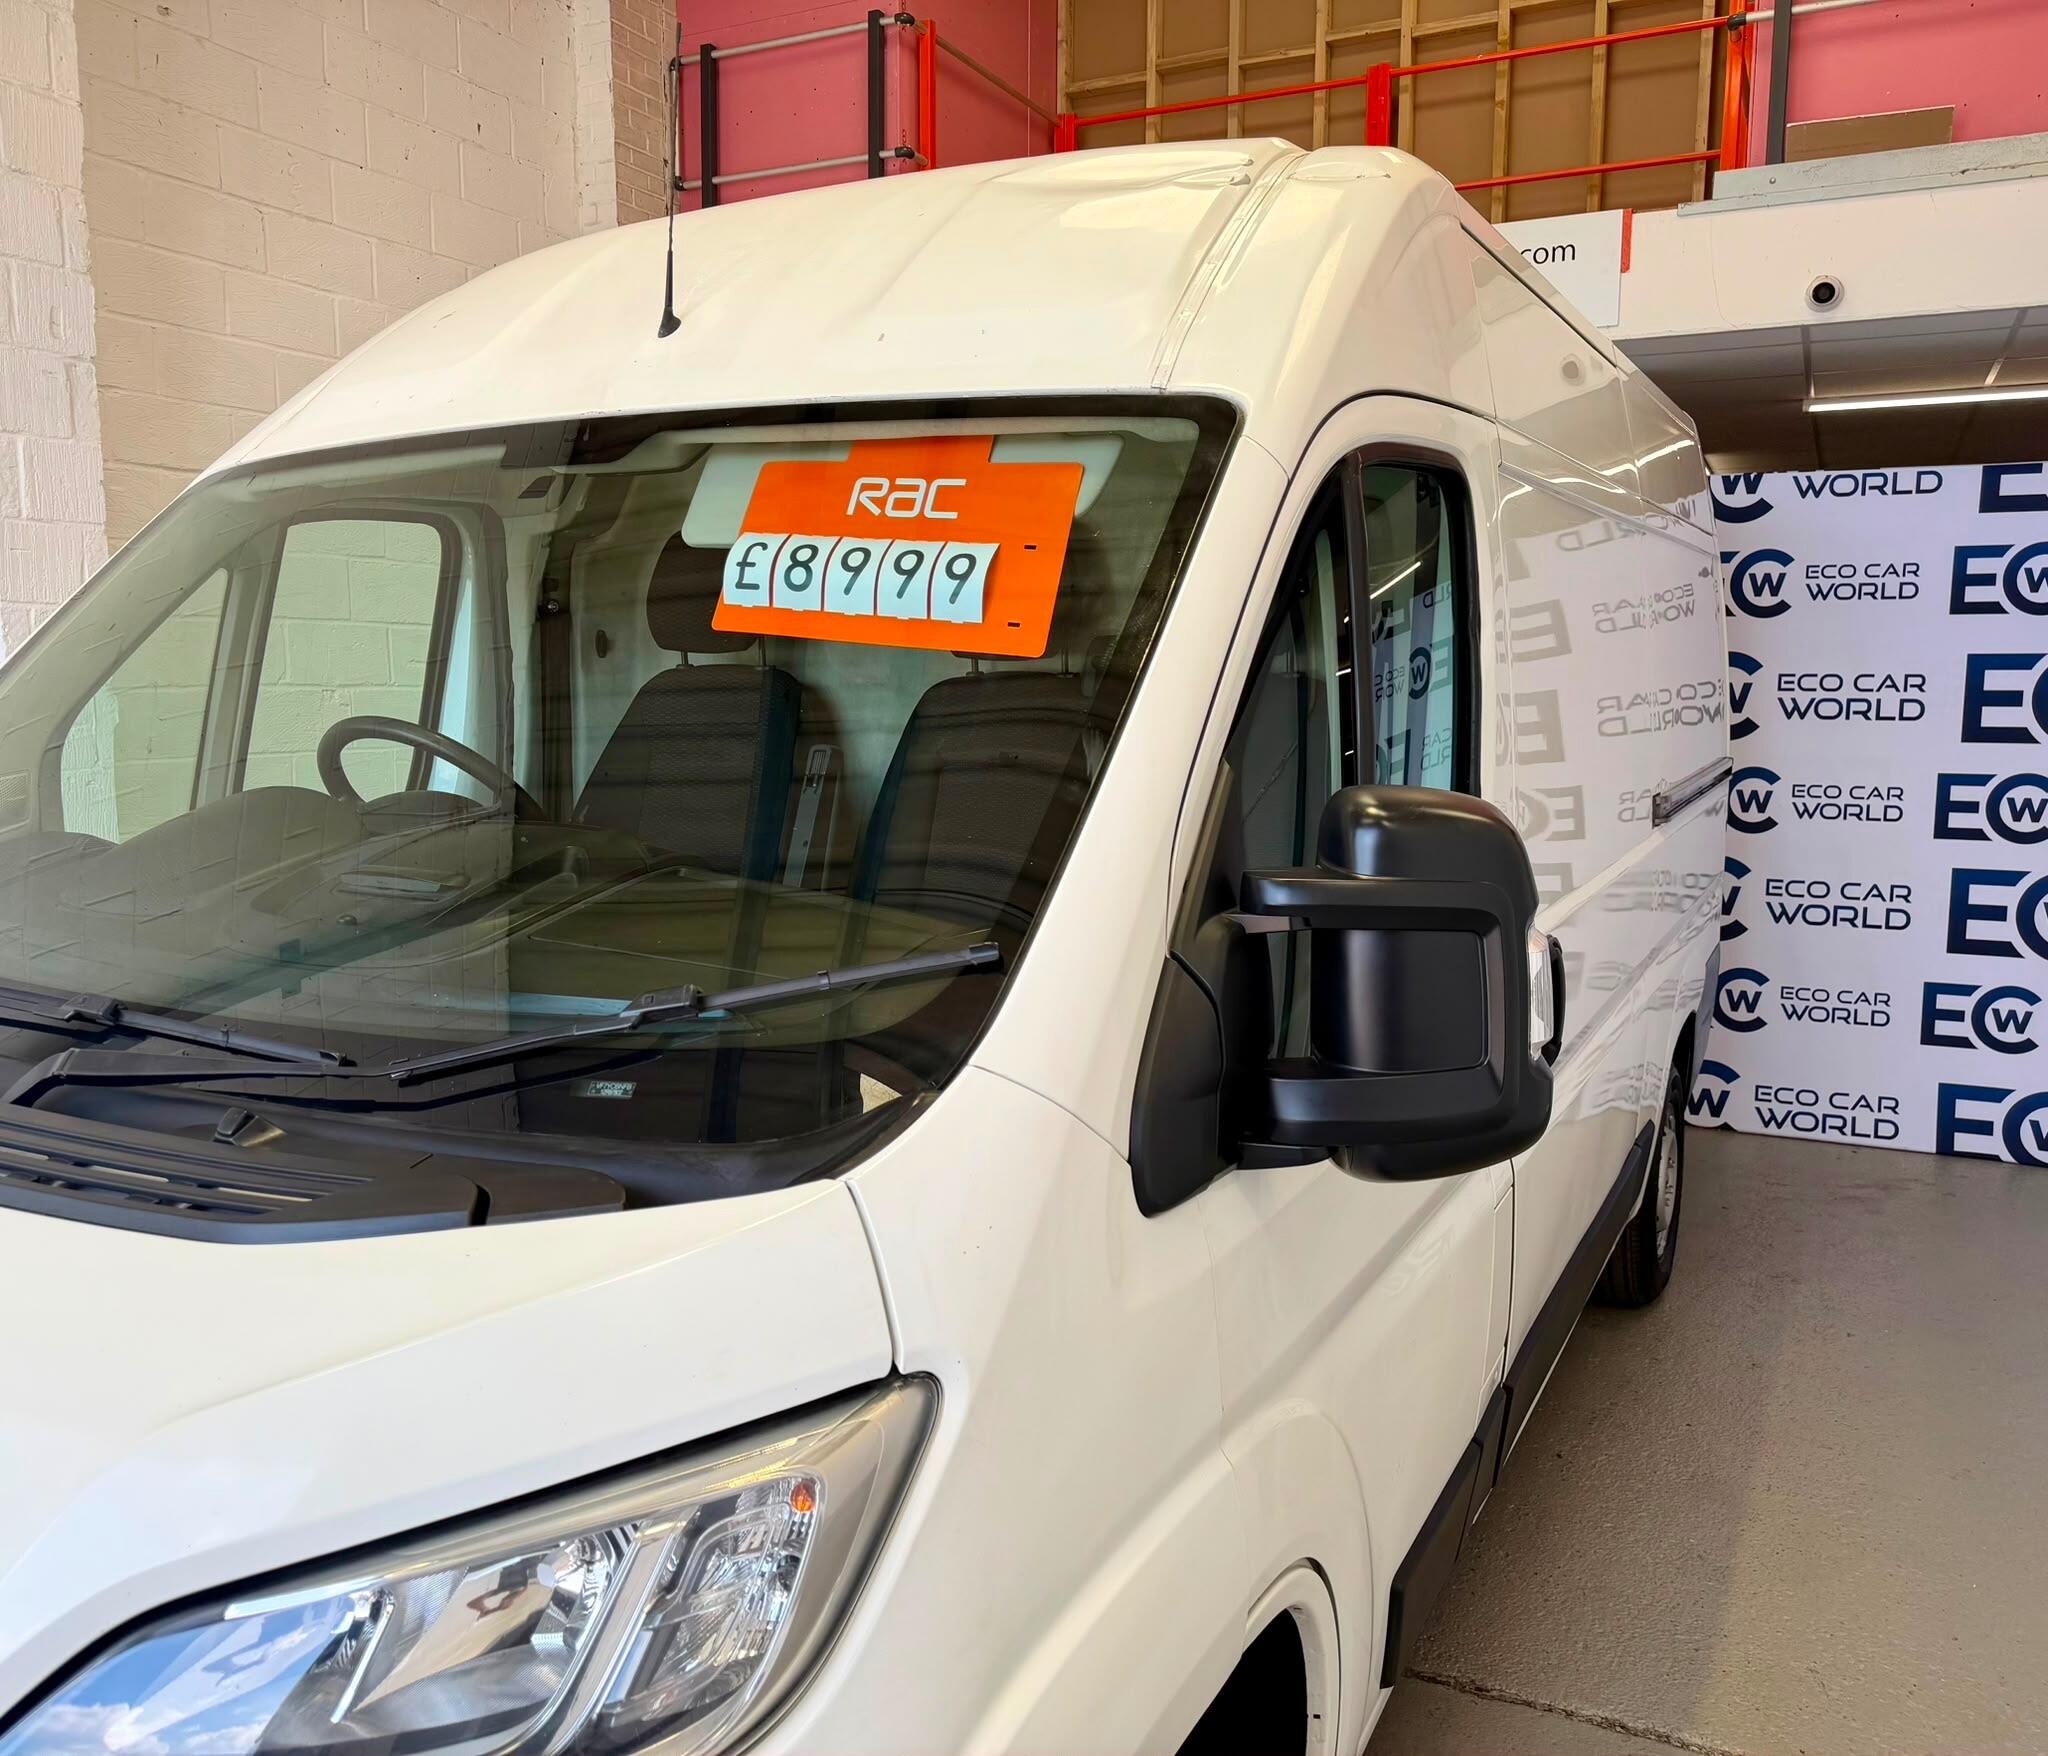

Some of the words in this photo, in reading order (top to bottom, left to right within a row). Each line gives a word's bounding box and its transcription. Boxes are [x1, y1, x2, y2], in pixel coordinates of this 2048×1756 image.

[1792, 470, 1943, 499] WORLD
[735, 541, 978, 605] £8999
[1805, 563, 1857, 579] ECO
[1863, 562, 1920, 578] CAR
[1805, 582, 1920, 601] WORLD
[1777, 673, 1844, 692] ECO
[1853, 673, 1927, 693] CAR
[1777, 697, 1926, 721] WORLD
[1791, 784, 1842, 799] ECO
[1849, 785, 1904, 801] CAR
[1791, 802, 1904, 822] WORLD
[1765, 878, 1831, 898] ECO
[1840, 882, 1912, 903] CAR
[1765, 902, 1912, 931] WORLD
[1780, 986, 1830, 1002] ECO
[1836, 990, 1891, 1007] CAR
[1780, 1004, 1891, 1028] WORLD
[1754, 1084, 1820, 1106] ECO
[1828, 1094, 1900, 1115] CAR
[1754, 1106, 1900, 1141] WORLD
